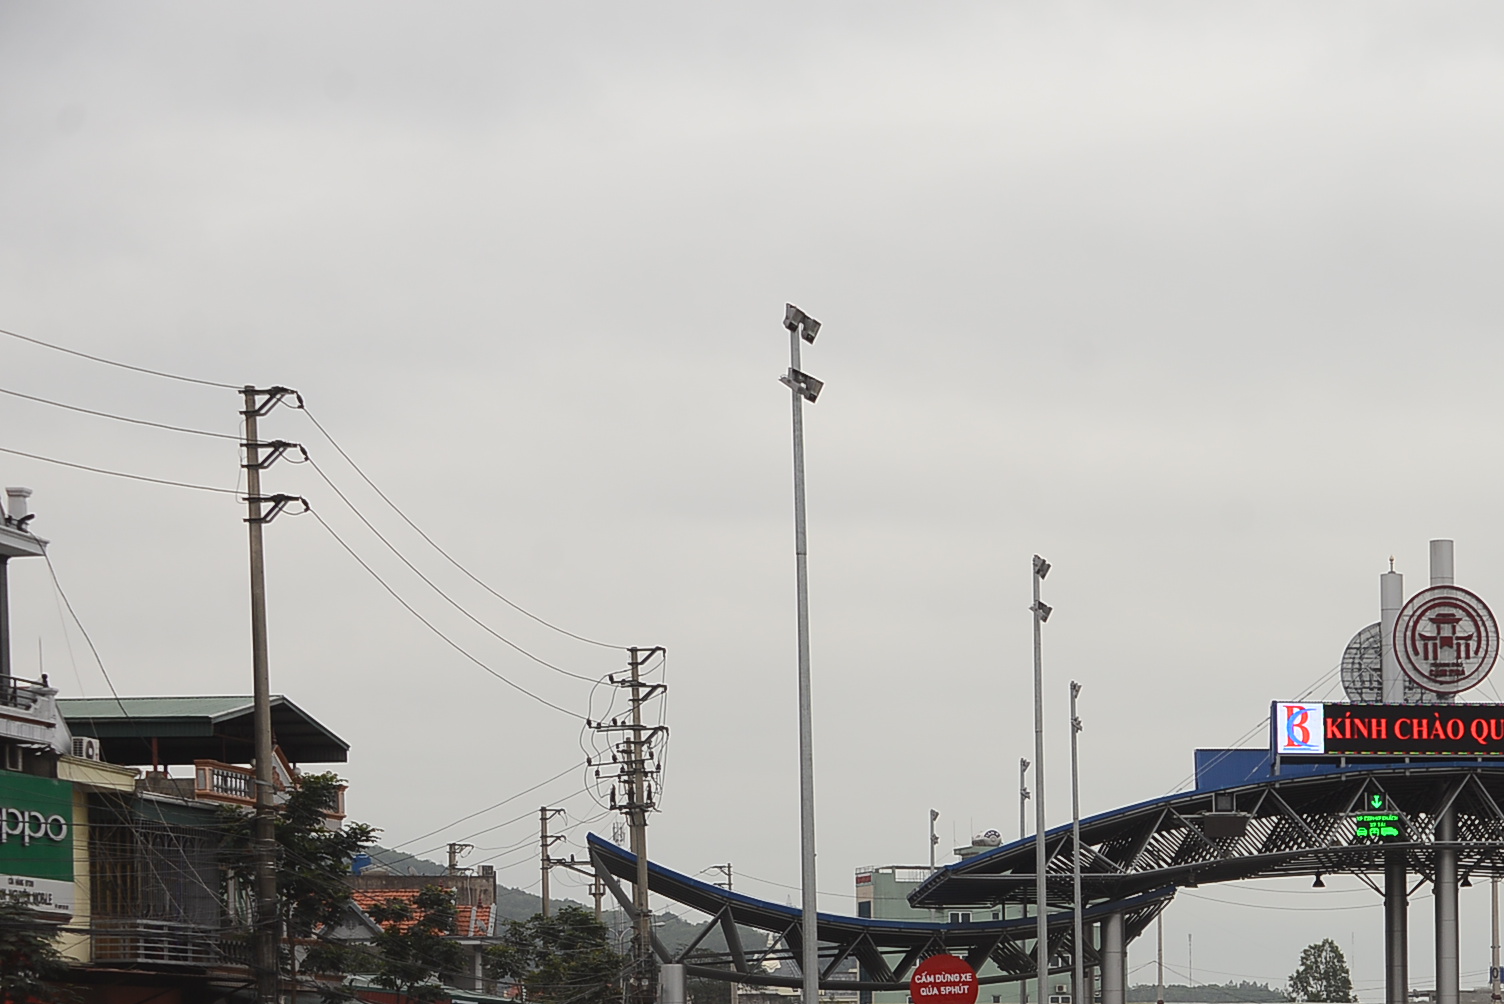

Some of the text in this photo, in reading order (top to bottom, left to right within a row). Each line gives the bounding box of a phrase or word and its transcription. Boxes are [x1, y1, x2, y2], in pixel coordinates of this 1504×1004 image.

[1326, 711, 1388, 739] KÍNH
[1394, 712, 1465, 740] CHÀO
[0, 807, 68, 846] ppo
[914, 971, 935, 983] CẤM
[960, 972, 973, 982] XE
